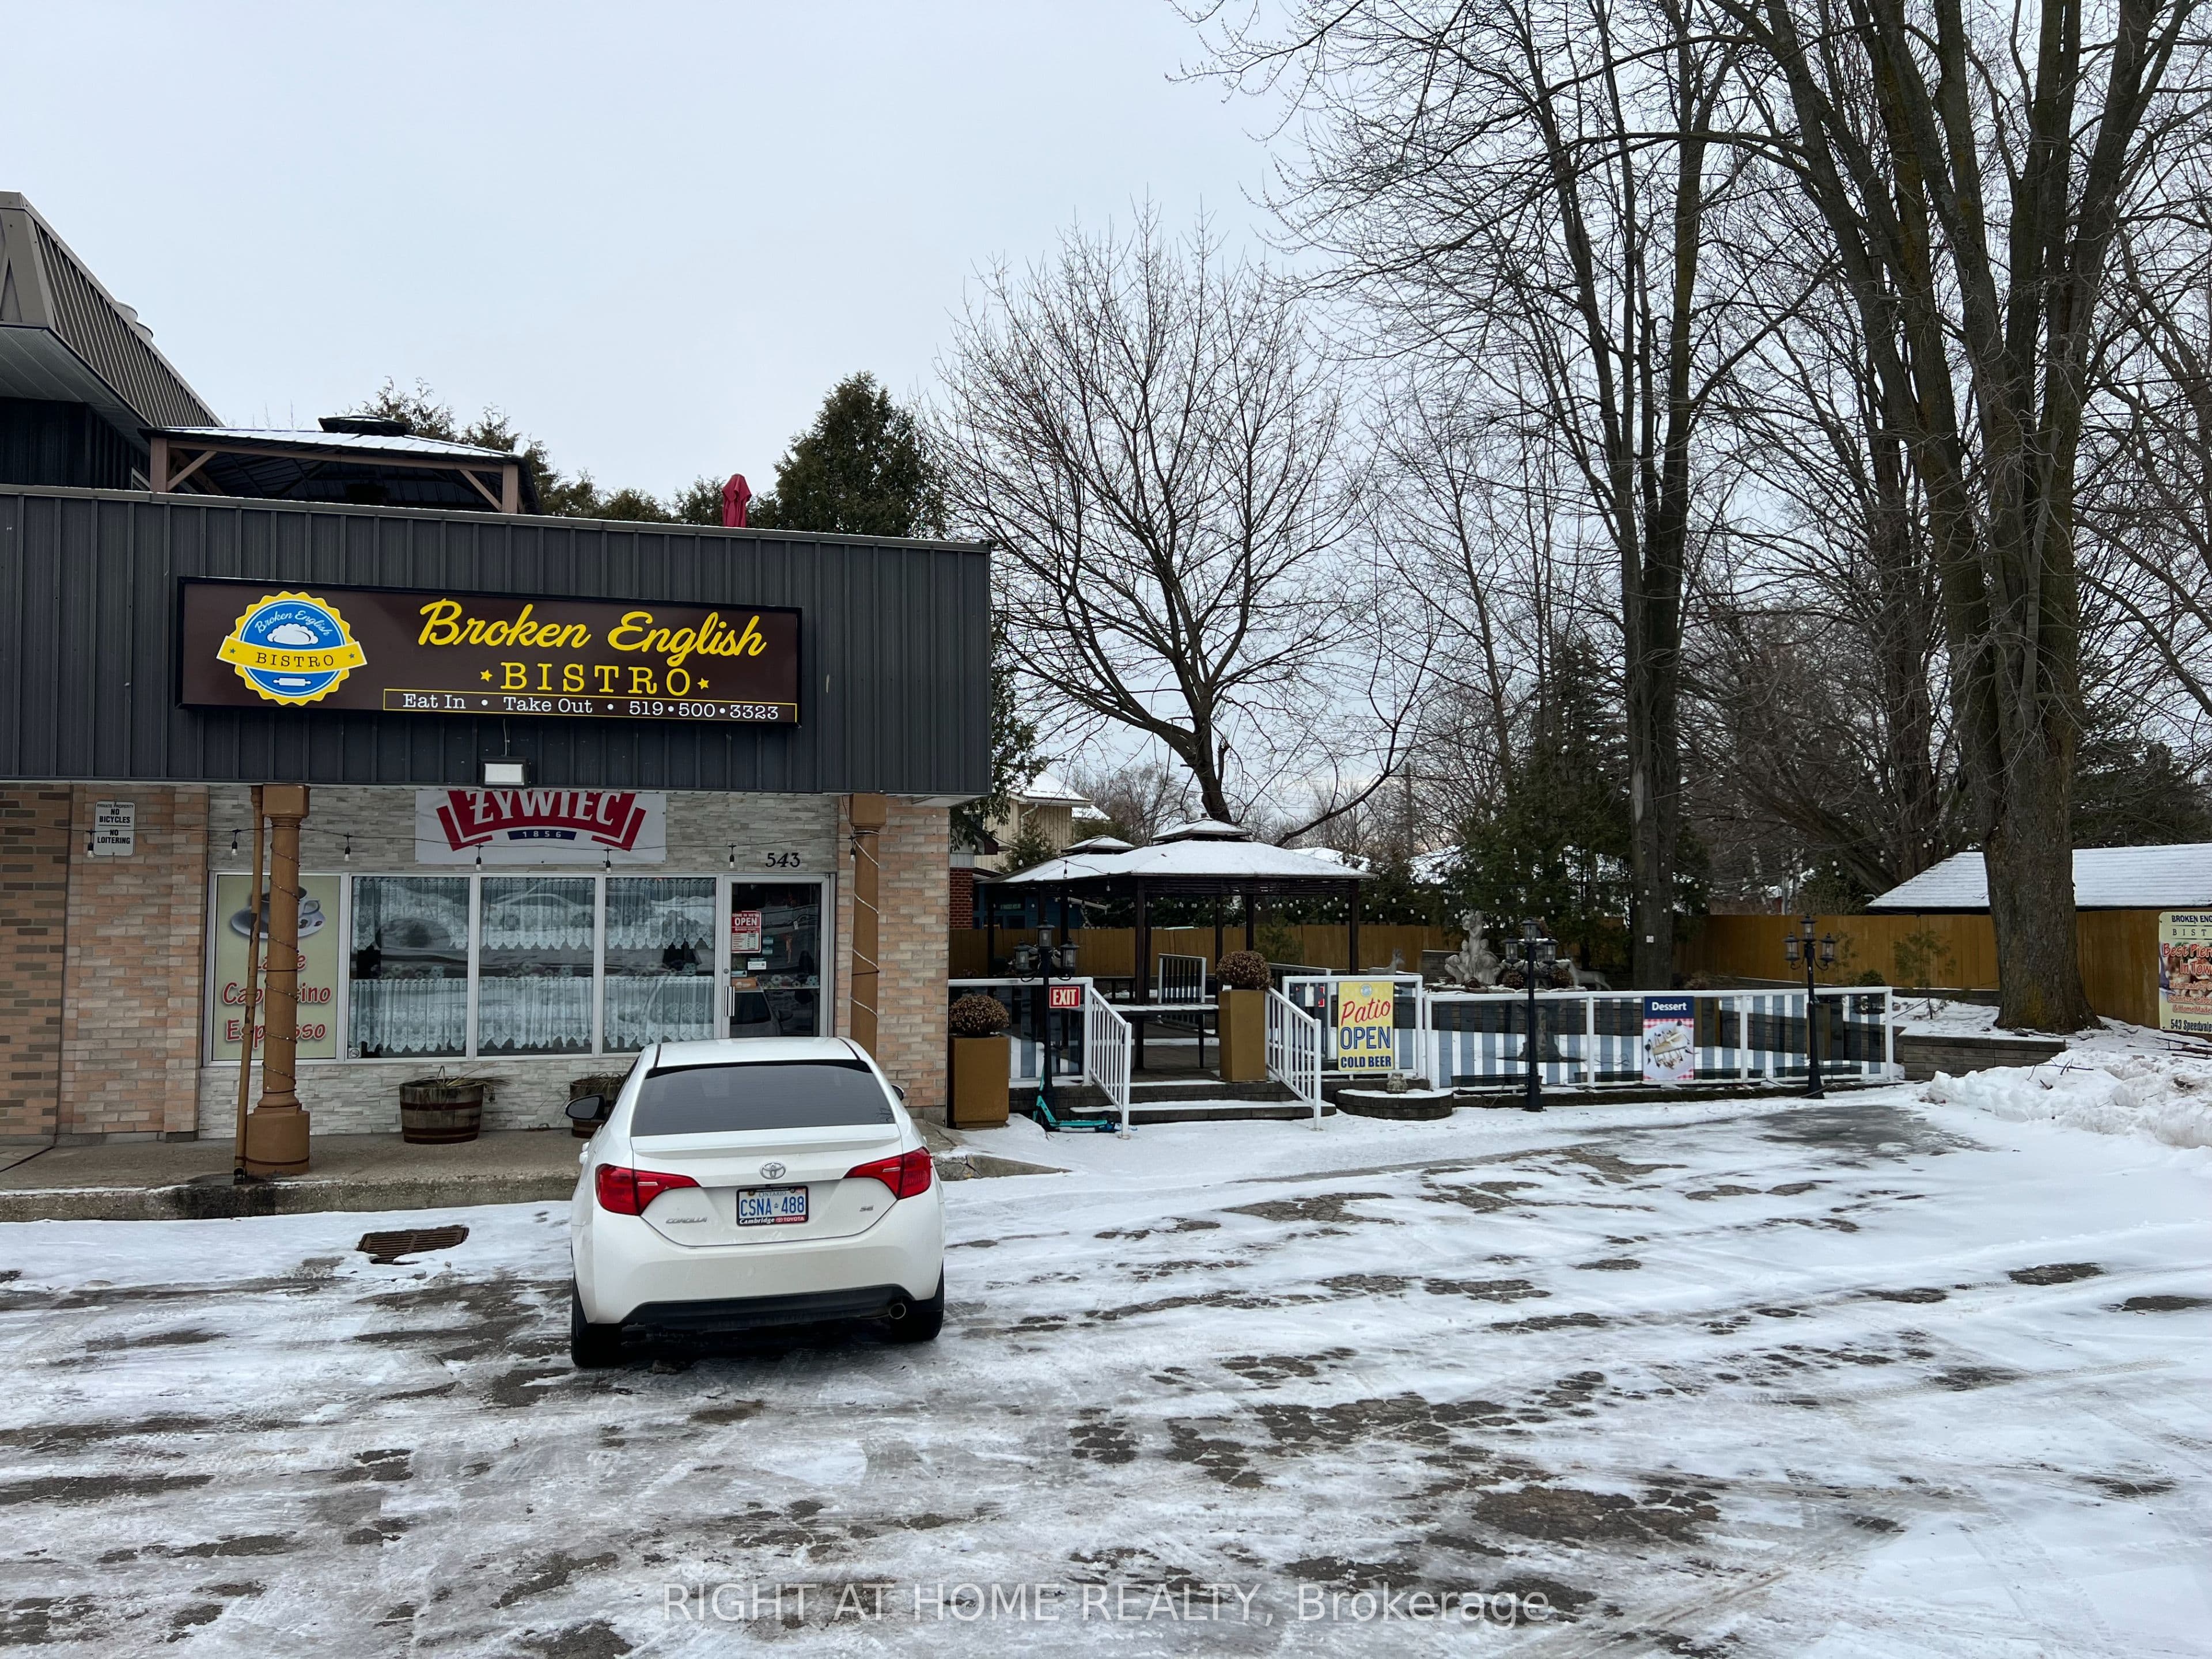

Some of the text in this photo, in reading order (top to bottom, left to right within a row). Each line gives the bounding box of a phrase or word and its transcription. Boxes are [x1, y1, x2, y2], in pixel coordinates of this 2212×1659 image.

[255, 611, 333, 635] Broken English
[418, 598, 767, 666] Broken English
[256, 652, 334, 667] BISTRO
[500, 662, 690, 696] BISTRO
[403, 694, 438, 709] Eat
[444, 695, 465, 709] In
[503, 696, 551, 711] Take
[558, 698, 593, 713] Out
[766, 853, 800, 868] 543
[734, 918, 757, 926] OPEN
[2163, 943, 2189, 956] Best
[2180, 960, 2190, 974] In
[1053, 989, 1076, 1005] EXIT
[1340, 997, 1391, 1026] Patio
[1652, 1002, 1687, 1011] Dessert
[2171, 1019, 2212, 1032] 543 Speedvale
[1340, 1026, 1391, 1050] OPEN
[1340, 1056, 1391, 1068] COLD BEER
[740, 1196, 804, 1216] CSNA 488
